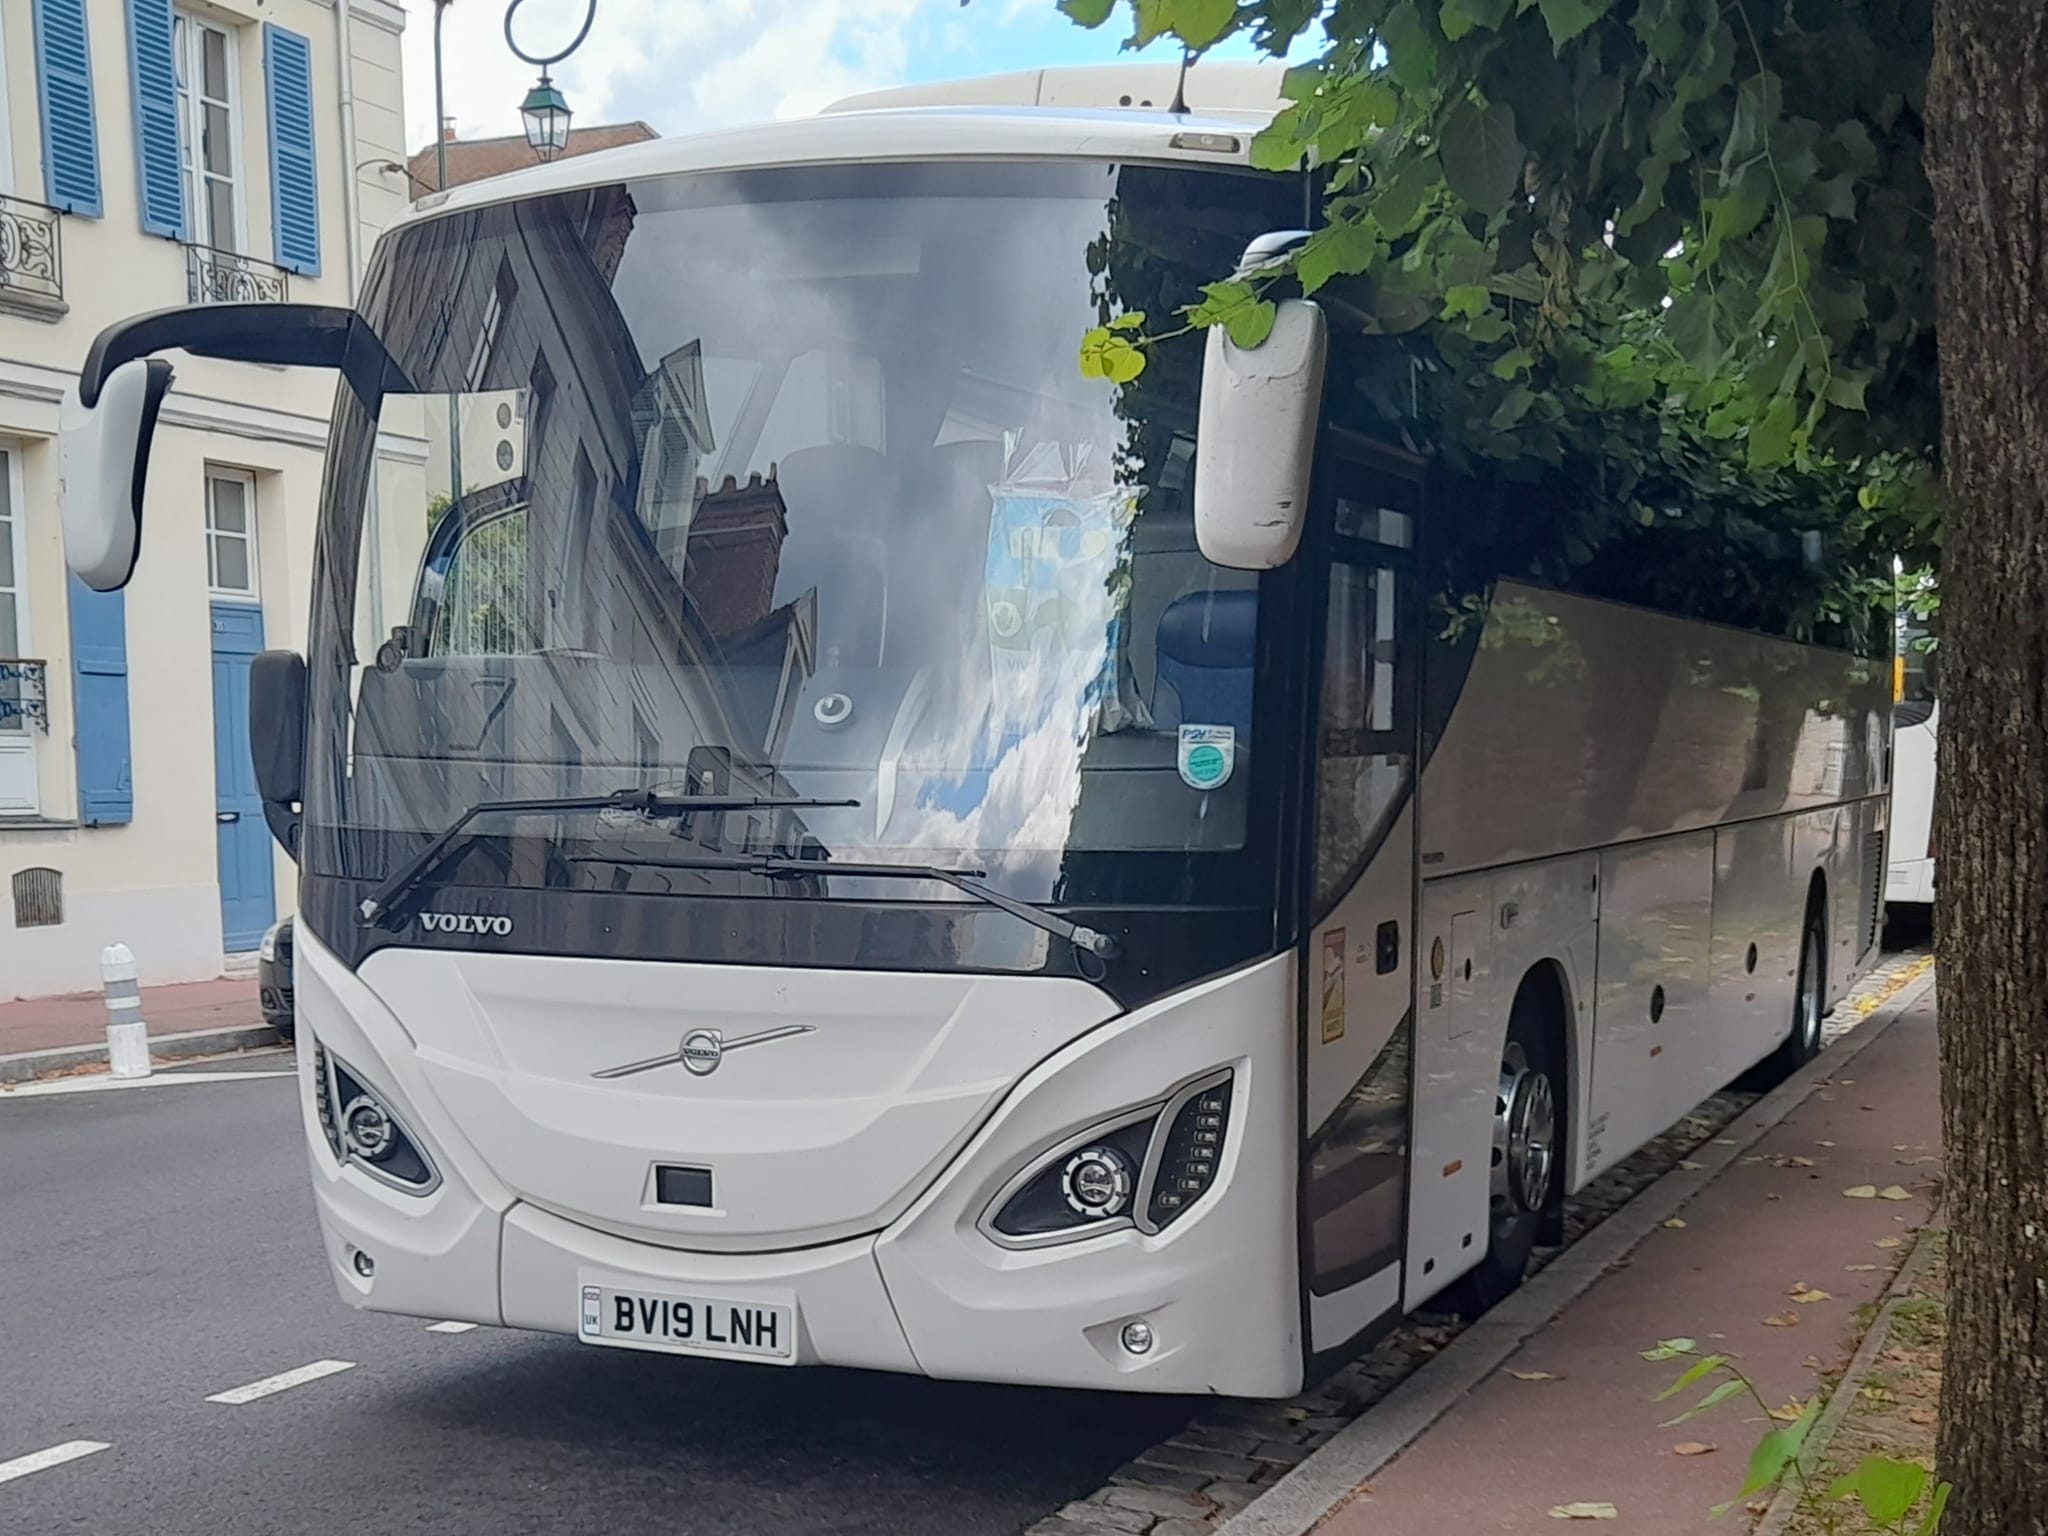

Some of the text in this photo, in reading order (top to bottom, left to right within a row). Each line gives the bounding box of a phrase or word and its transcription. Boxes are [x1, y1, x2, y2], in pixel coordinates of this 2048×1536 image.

[418, 912, 513, 936] VOLVO
[585, 1313, 599, 1326] UK
[614, 1295, 777, 1348] BV19 LNH
